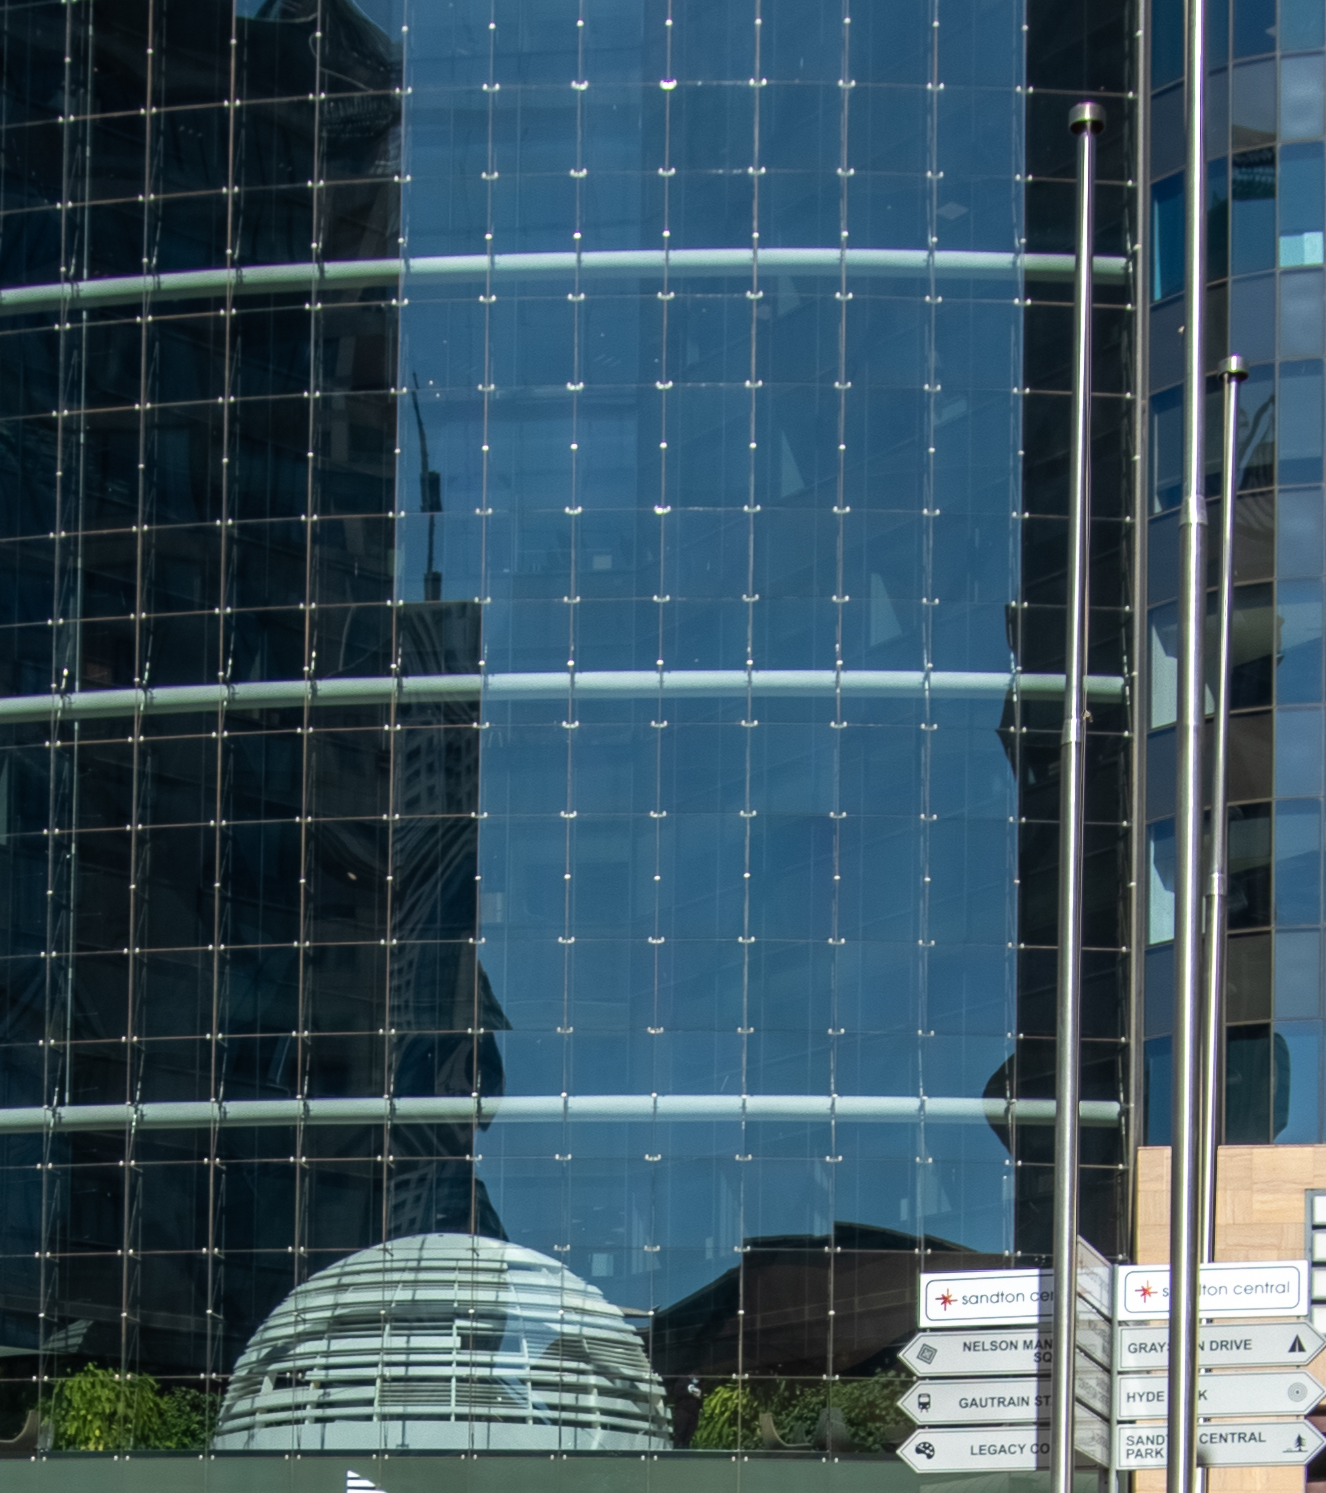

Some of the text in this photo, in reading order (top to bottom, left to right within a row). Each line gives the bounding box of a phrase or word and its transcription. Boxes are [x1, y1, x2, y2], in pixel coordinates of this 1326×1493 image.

[1233, 1280, 1290, 1296] central
[961, 1291, 1025, 1306] sandton
[962, 1339, 1019, 1352] NELSON
[1209, 1338, 1253, 1352] DRIVE
[958, 1396, 1030, 1409] GAUTRAIN
[1126, 1390, 1165, 1403] HYDE
[1198, 1432, 1267, 1445] CENTRAL
[970, 1443, 1027, 1456] LEGACY
[1126, 1447, 1165, 1459] PARK
